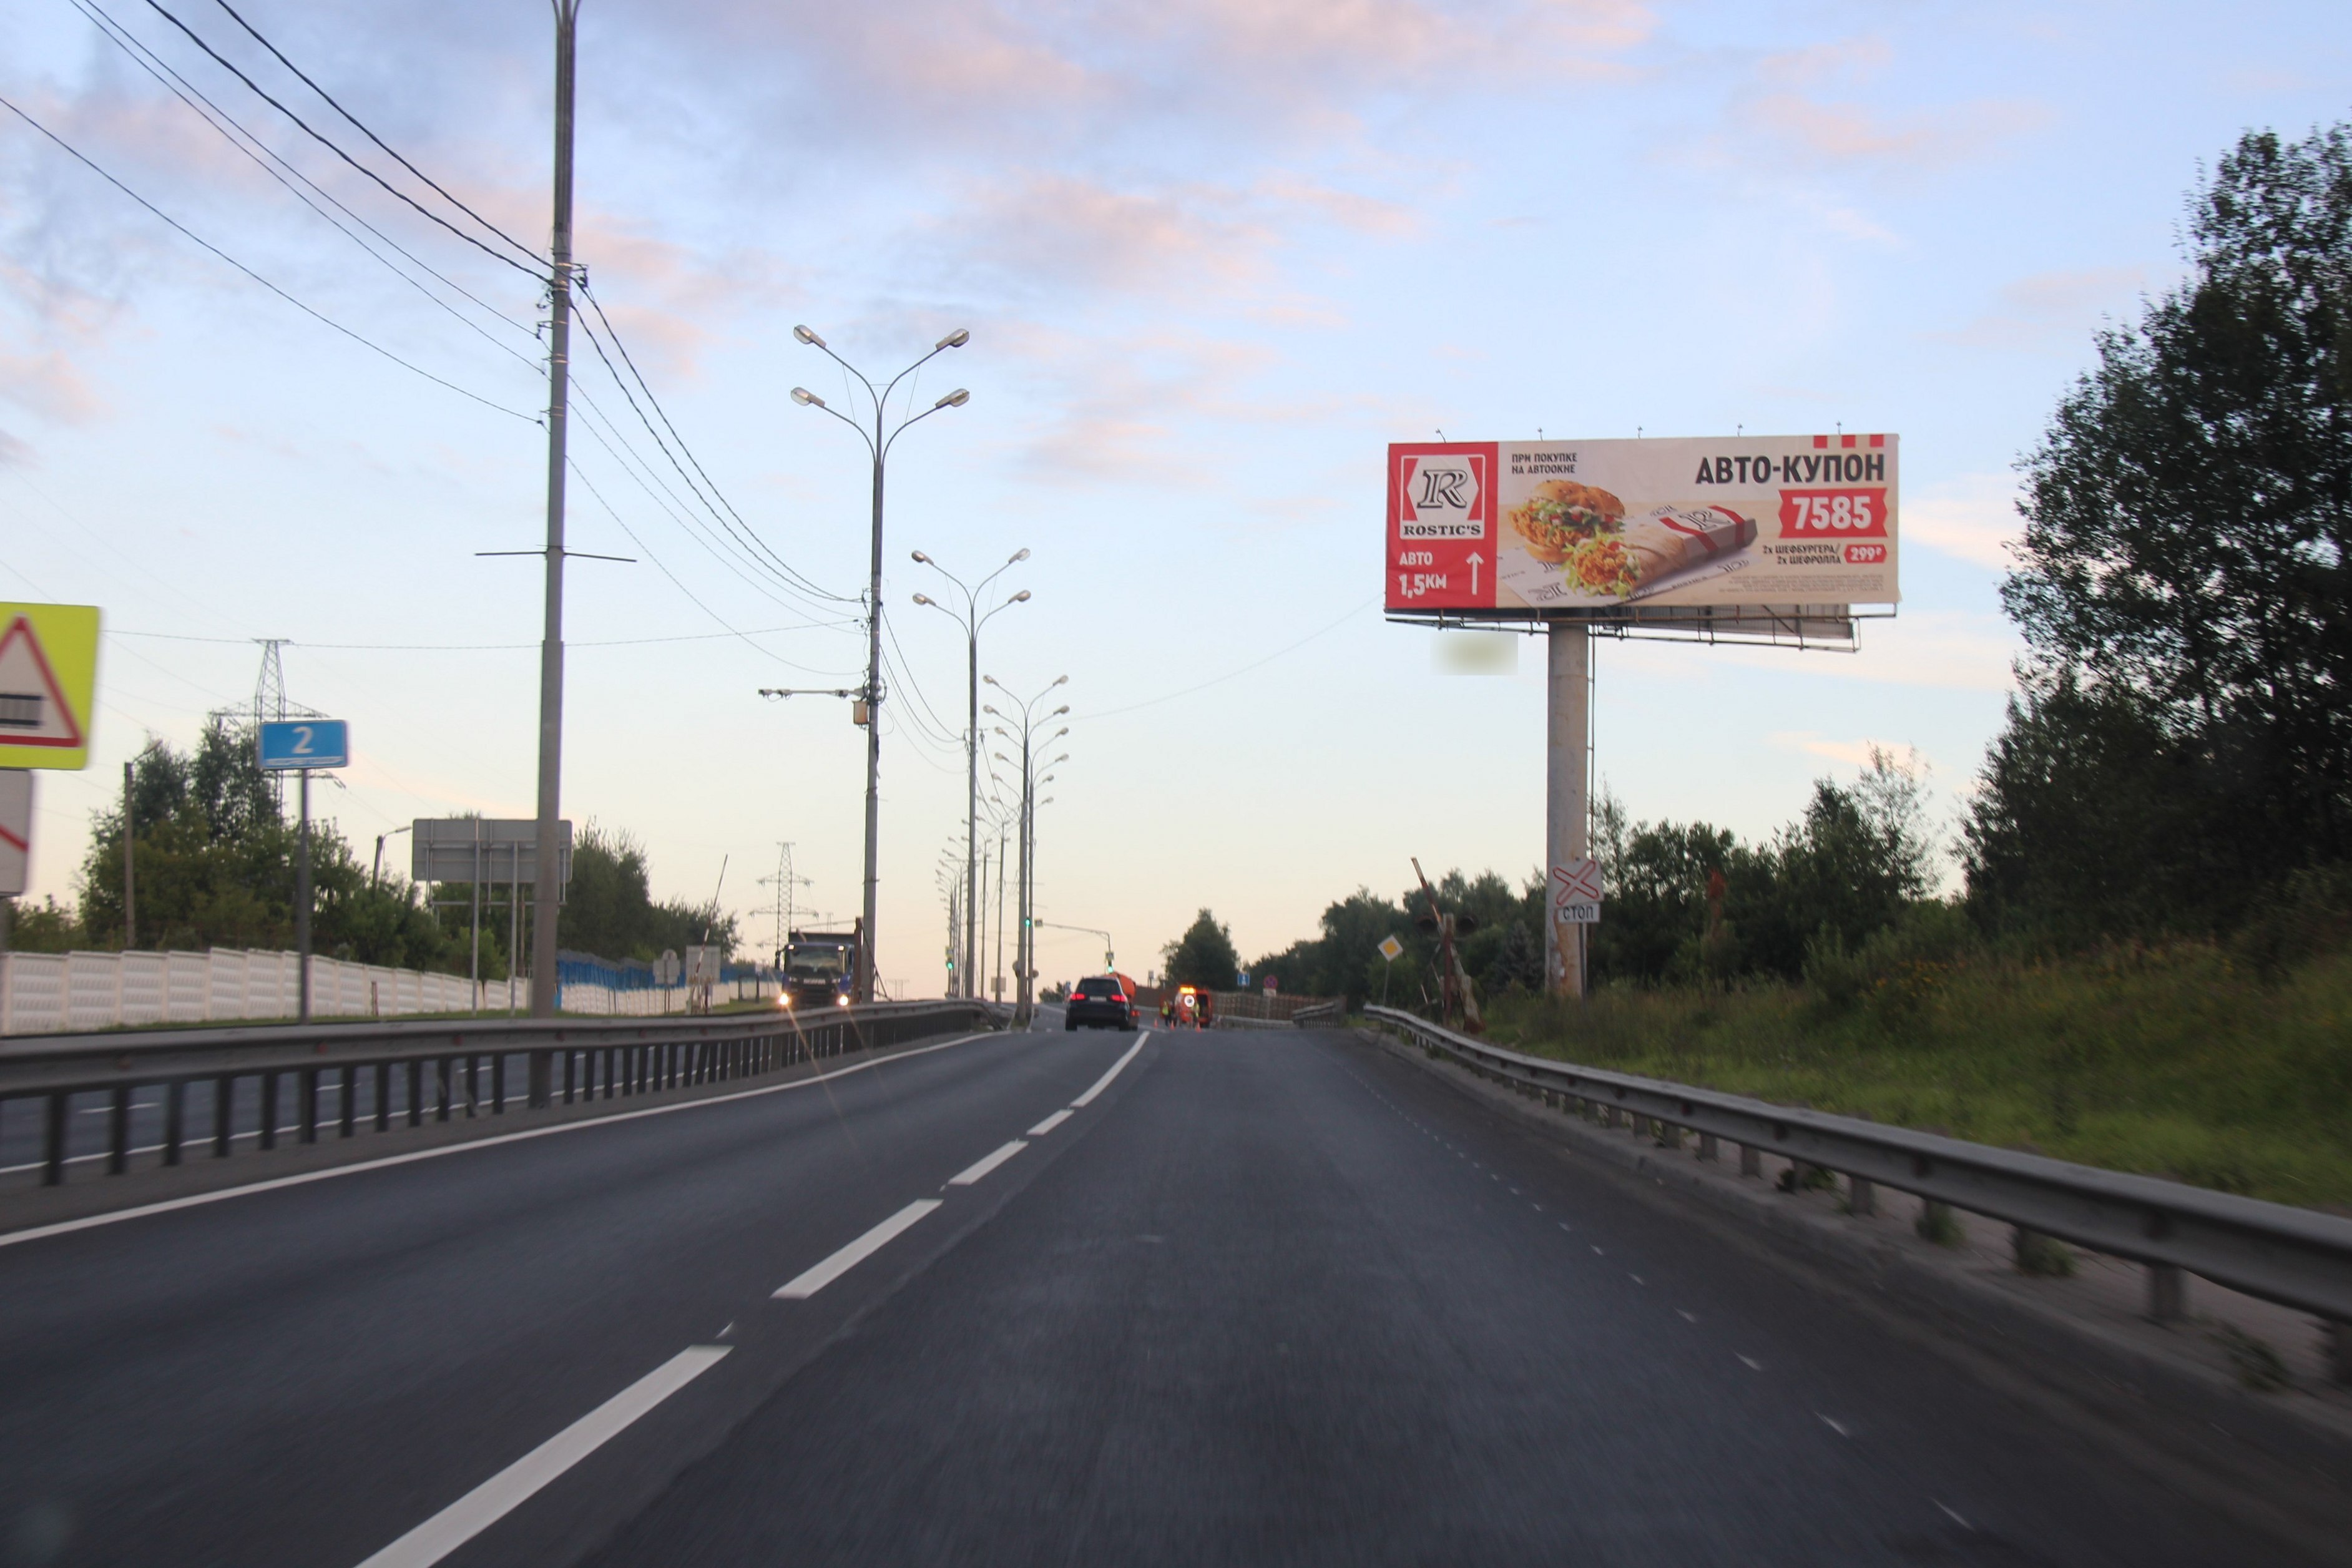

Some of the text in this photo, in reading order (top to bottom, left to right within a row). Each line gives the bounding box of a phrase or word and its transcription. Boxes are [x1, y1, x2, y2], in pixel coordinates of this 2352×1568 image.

[1512, 453, 1577, 463] ПРИ ПОКУПКЕ
[1512, 464, 1575, 474] НА АВТООКНЕ
[1695, 454, 1884, 484] АВТО-КУПОН
[1417, 469, 1468, 508] R
[1792, 496, 1871, 529] 7585
[1403, 525, 1481, 536] ROSTIC'S
[1399, 552, 1433, 566] АВТО
[293, 726, 313, 754] 2
[1563, 905, 1593, 920] СТОП
